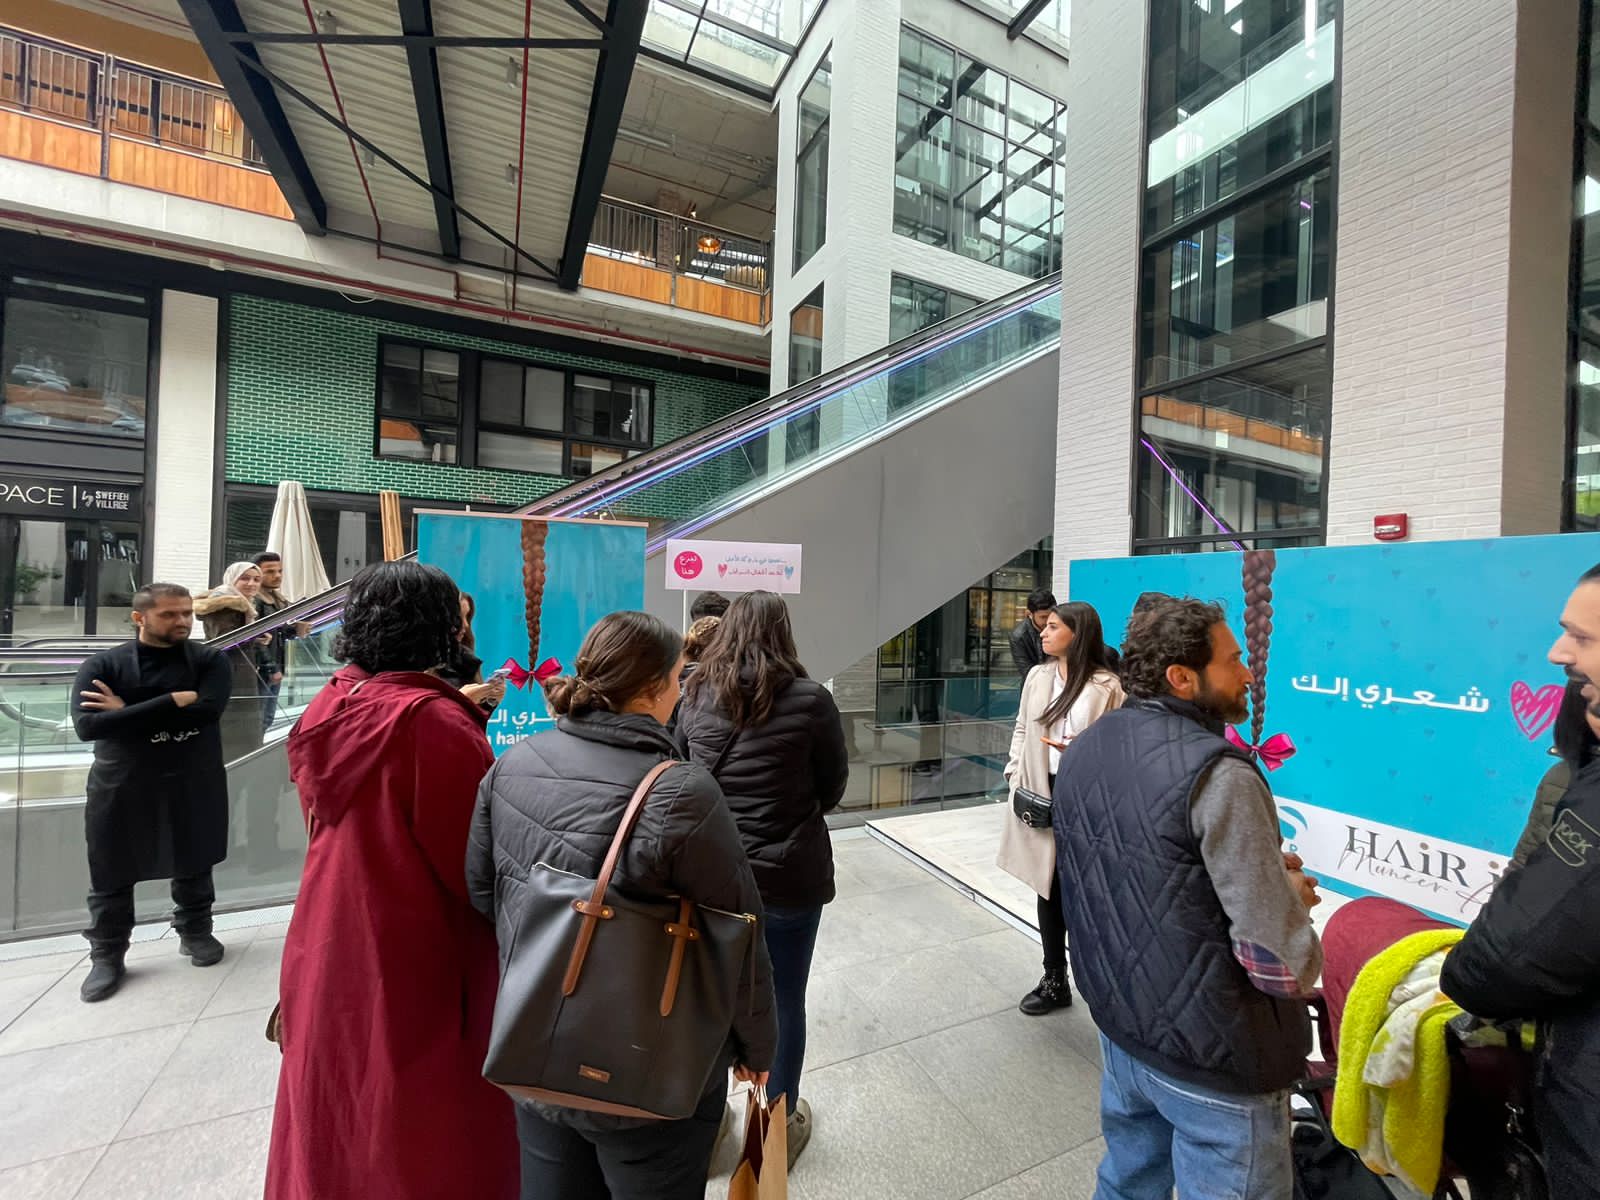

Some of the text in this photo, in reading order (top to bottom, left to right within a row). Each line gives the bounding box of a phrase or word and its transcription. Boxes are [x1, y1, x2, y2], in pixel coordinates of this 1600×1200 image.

[95, 500, 129, 511] VILLAGE
[1291, 673, 1490, 713] شعري إلك
